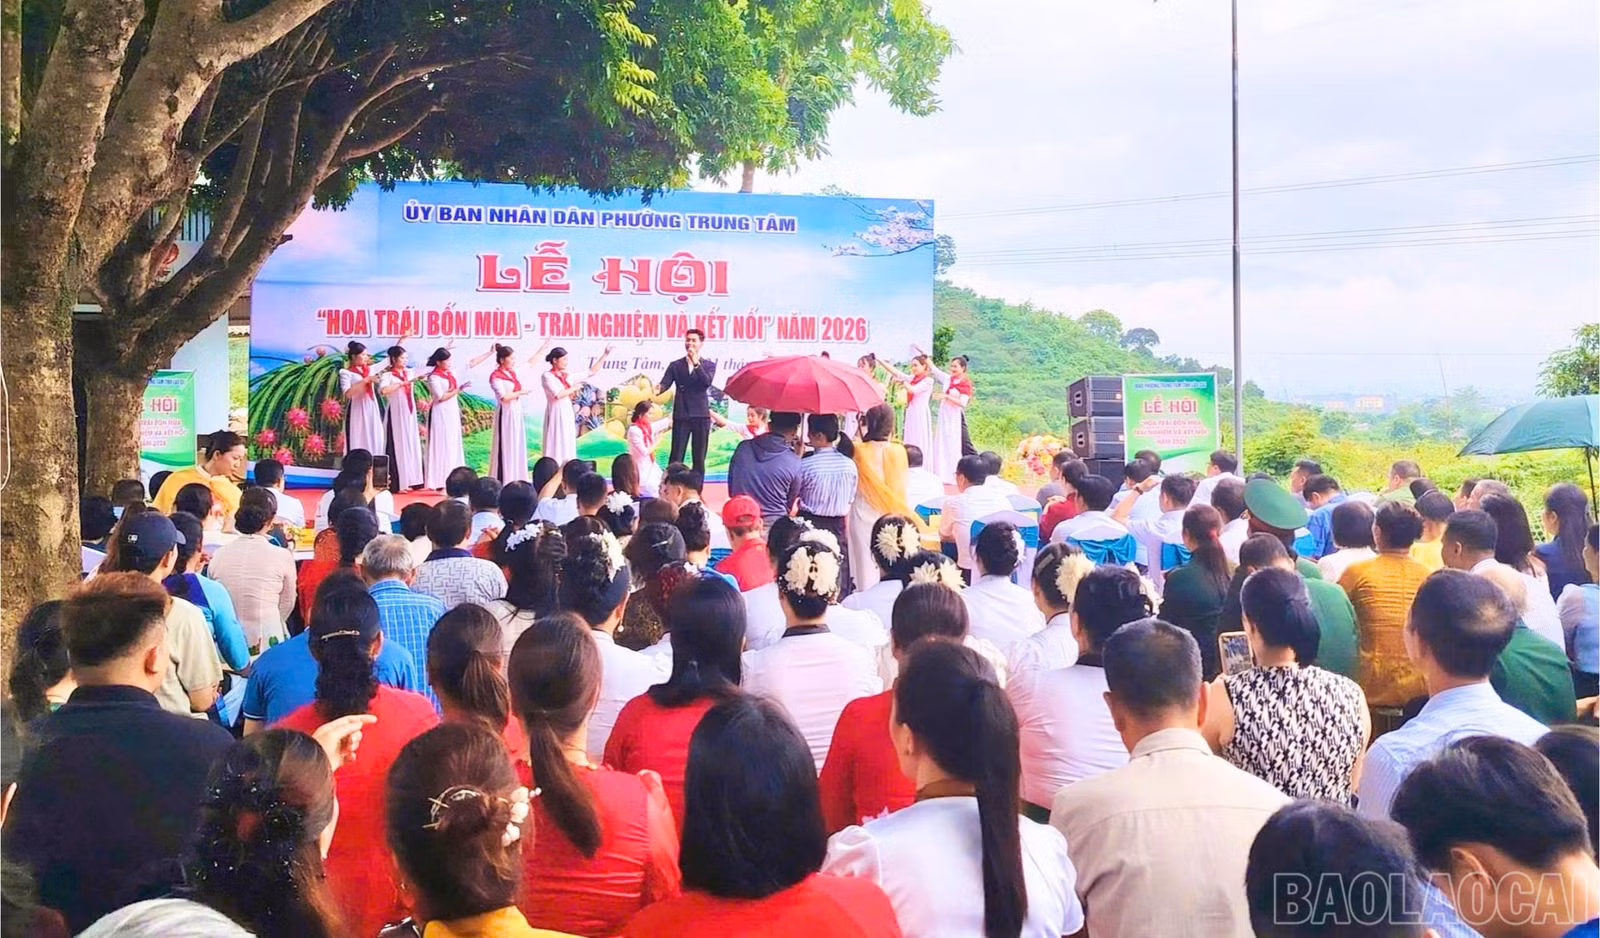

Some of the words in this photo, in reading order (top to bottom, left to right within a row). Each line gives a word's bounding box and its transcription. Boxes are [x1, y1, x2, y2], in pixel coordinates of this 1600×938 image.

[405, 201, 433, 220] ỦY
[438, 206, 482, 222] BAN
[489, 206, 547, 224] NHÂN
[553, 208, 595, 226] DÂN
[601, 210, 681, 229] PHƯỜNG
[688, 215, 750, 231] TRUNG
[755, 214, 796, 232] TÂM
[477, 241, 570, 292] LỄ
[593, 251, 729, 303] HỘI
[374, 306, 421, 336] TRÁI
[427, 302, 468, 336] BỐN
[474, 307, 519, 337] MÙA
[537, 306, 581, 337] TRẢI
[587, 309, 659, 342] NGHIỆM
[665, 310, 688, 338] VÀ
[695, 306, 728, 339] KẾT
[777, 312, 816, 340] NĂM
[821, 316, 867, 341] 2026
[586, 356, 628, 372] Tung
[632, 356, 665, 371] Tâm,
[150, 396, 177, 415] HỘI
[1168, 397, 1197, 416] HỘI
